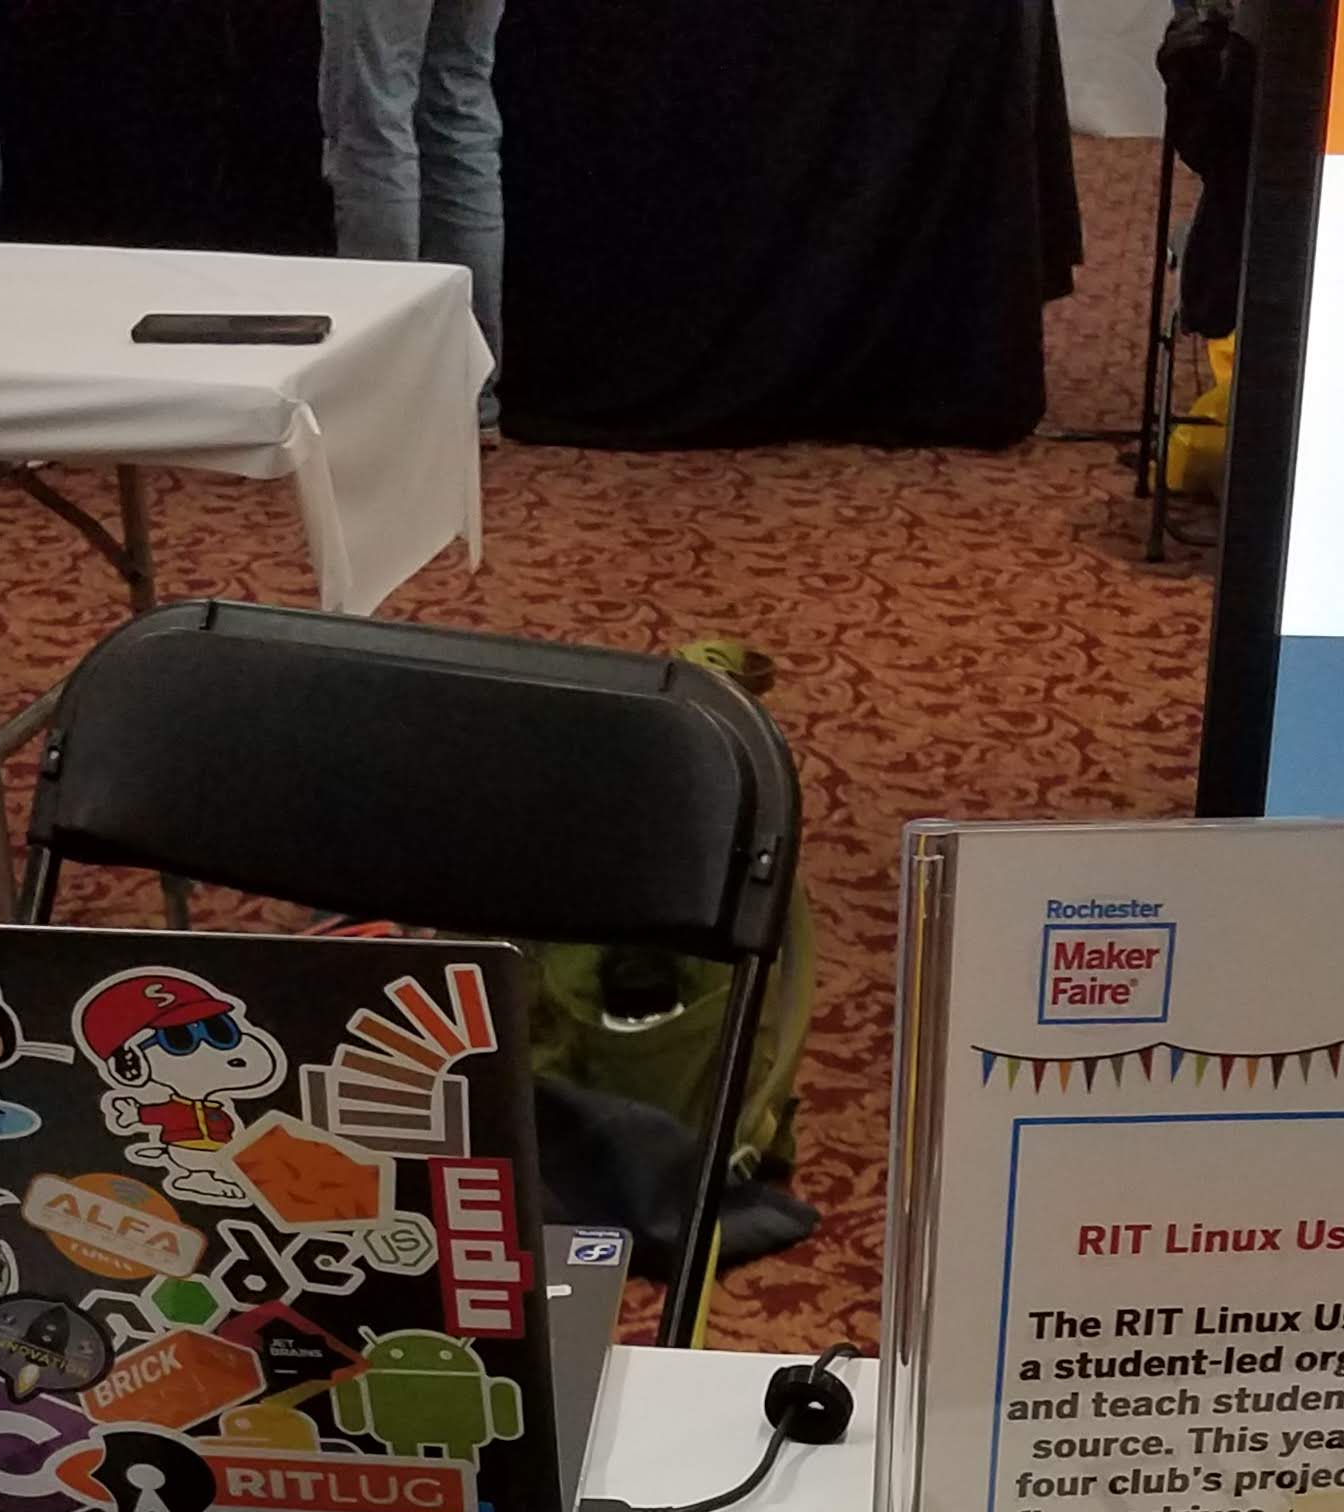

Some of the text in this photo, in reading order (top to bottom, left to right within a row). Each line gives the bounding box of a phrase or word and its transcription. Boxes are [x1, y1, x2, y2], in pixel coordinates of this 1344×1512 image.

[1047, 900, 1163, 919] Rochester
[1054, 941, 1160, 970] Maker
[45, 1193, 182, 1257] ALFA
[1077, 1223, 1152, 1256] RIT
[1165, 1221, 1282, 1254] Linux
[442, 1166, 521, 1330] npm
[1029, 1310, 1102, 1339] The
[1113, 1307, 1183, 1337] RIT
[1194, 1304, 1302, 1335] Linux
[95, 1344, 184, 1407] BRICK
[1018, 1359, 1042, 1381] a
[1054, 1346, 1284, 1381] student-led
[1007, 1393, 1079, 1423] and
[1091, 1389, 1200, 1419] teach
[1033, 1432, 1176, 1461] source.
[1187, 1426, 1271, 1456] This
[224, 1466, 444, 1508] RITLUG
[1016, 1469, 1097, 1500] four
[1107, 1465, 1223, 1498] club's
